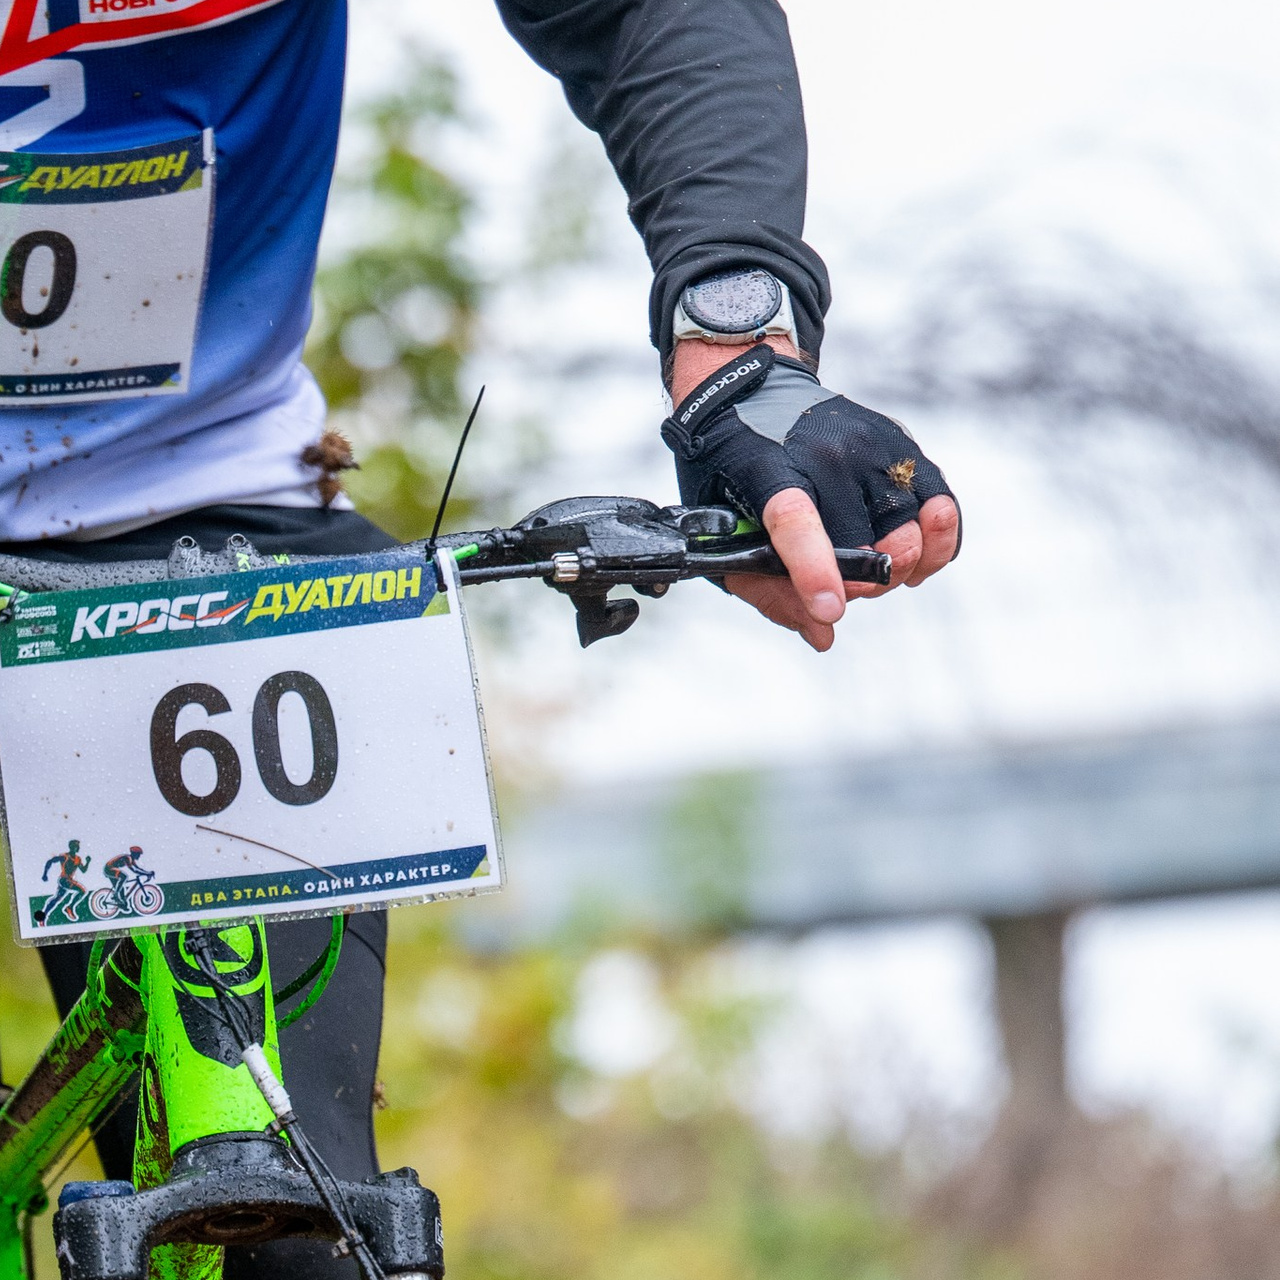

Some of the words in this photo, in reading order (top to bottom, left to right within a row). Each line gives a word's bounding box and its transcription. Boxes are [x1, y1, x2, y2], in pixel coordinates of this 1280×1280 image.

[17, 150, 189, 194] ДУАТЛОН
[680, 359, 762, 425] ROCKBROS
[70, 590, 234, 644] КРОСС
[244, 567, 422, 626] ДУАТЛОН
[149, 670, 339, 817] 60
[190, 890, 228, 906] ДВА
[232, 884, 300, 901] ЭТАПА.
[303, 876, 355, 894] ОДИН
[360, 863, 458, 888] ХАРАКТЕР.
